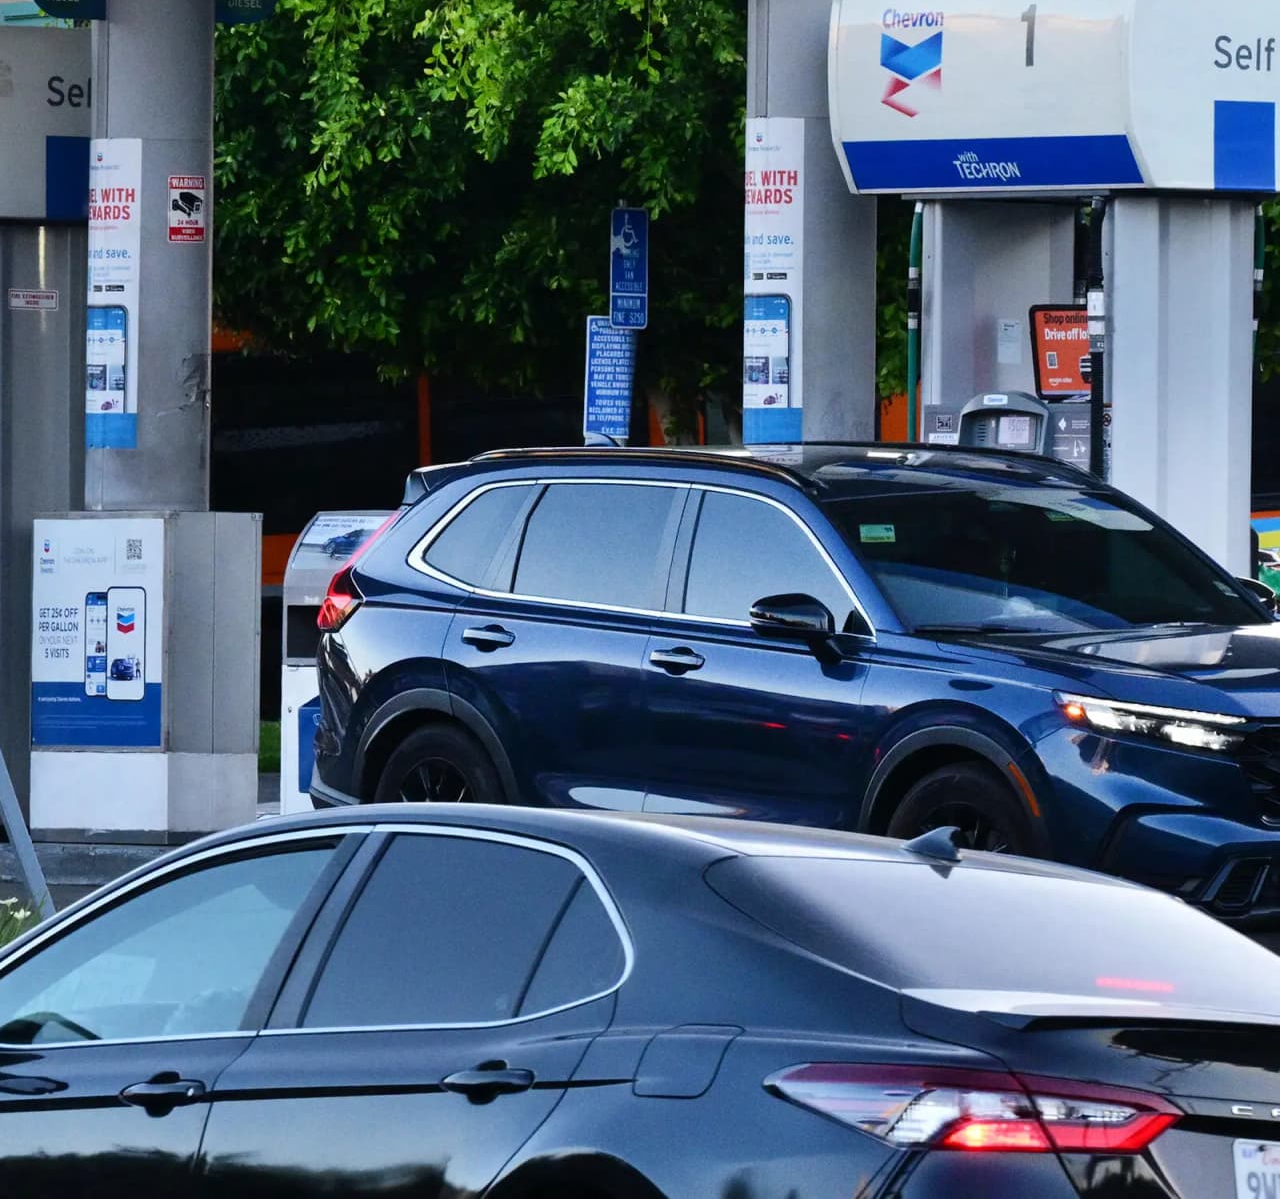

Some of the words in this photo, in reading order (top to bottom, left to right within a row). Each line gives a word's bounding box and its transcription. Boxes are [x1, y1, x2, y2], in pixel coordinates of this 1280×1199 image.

[882, 8, 944, 29] Chevron
[1021, 3, 1037, 66] 1
[1214, 35, 1275, 72] Self
[47, 76, 91, 107] Sel
[957, 151, 978, 162] with
[953, 159, 1021, 181] TECHRON
[171, 177, 203, 188] WARNING
[761, 170, 798, 186] WITH
[101, 188, 136, 203] WITH
[745, 188, 793, 204] EWARDS
[89, 205, 131, 221] EWARDS
[767, 234, 794, 245] save.
[105, 249, 131, 258] save.
[1043, 313, 1064, 325] Shop
[1065, 313, 1088, 324] onlin
[1044, 328, 1066, 340] Drive
[1067, 328, 1079, 340] off
[39, 607, 51, 618] GET
[64, 607, 79, 618] OFF
[39, 622, 50, 632] PER
[50, 622, 79, 632] GALLON
[49, 648, 70, 659] VISITS
